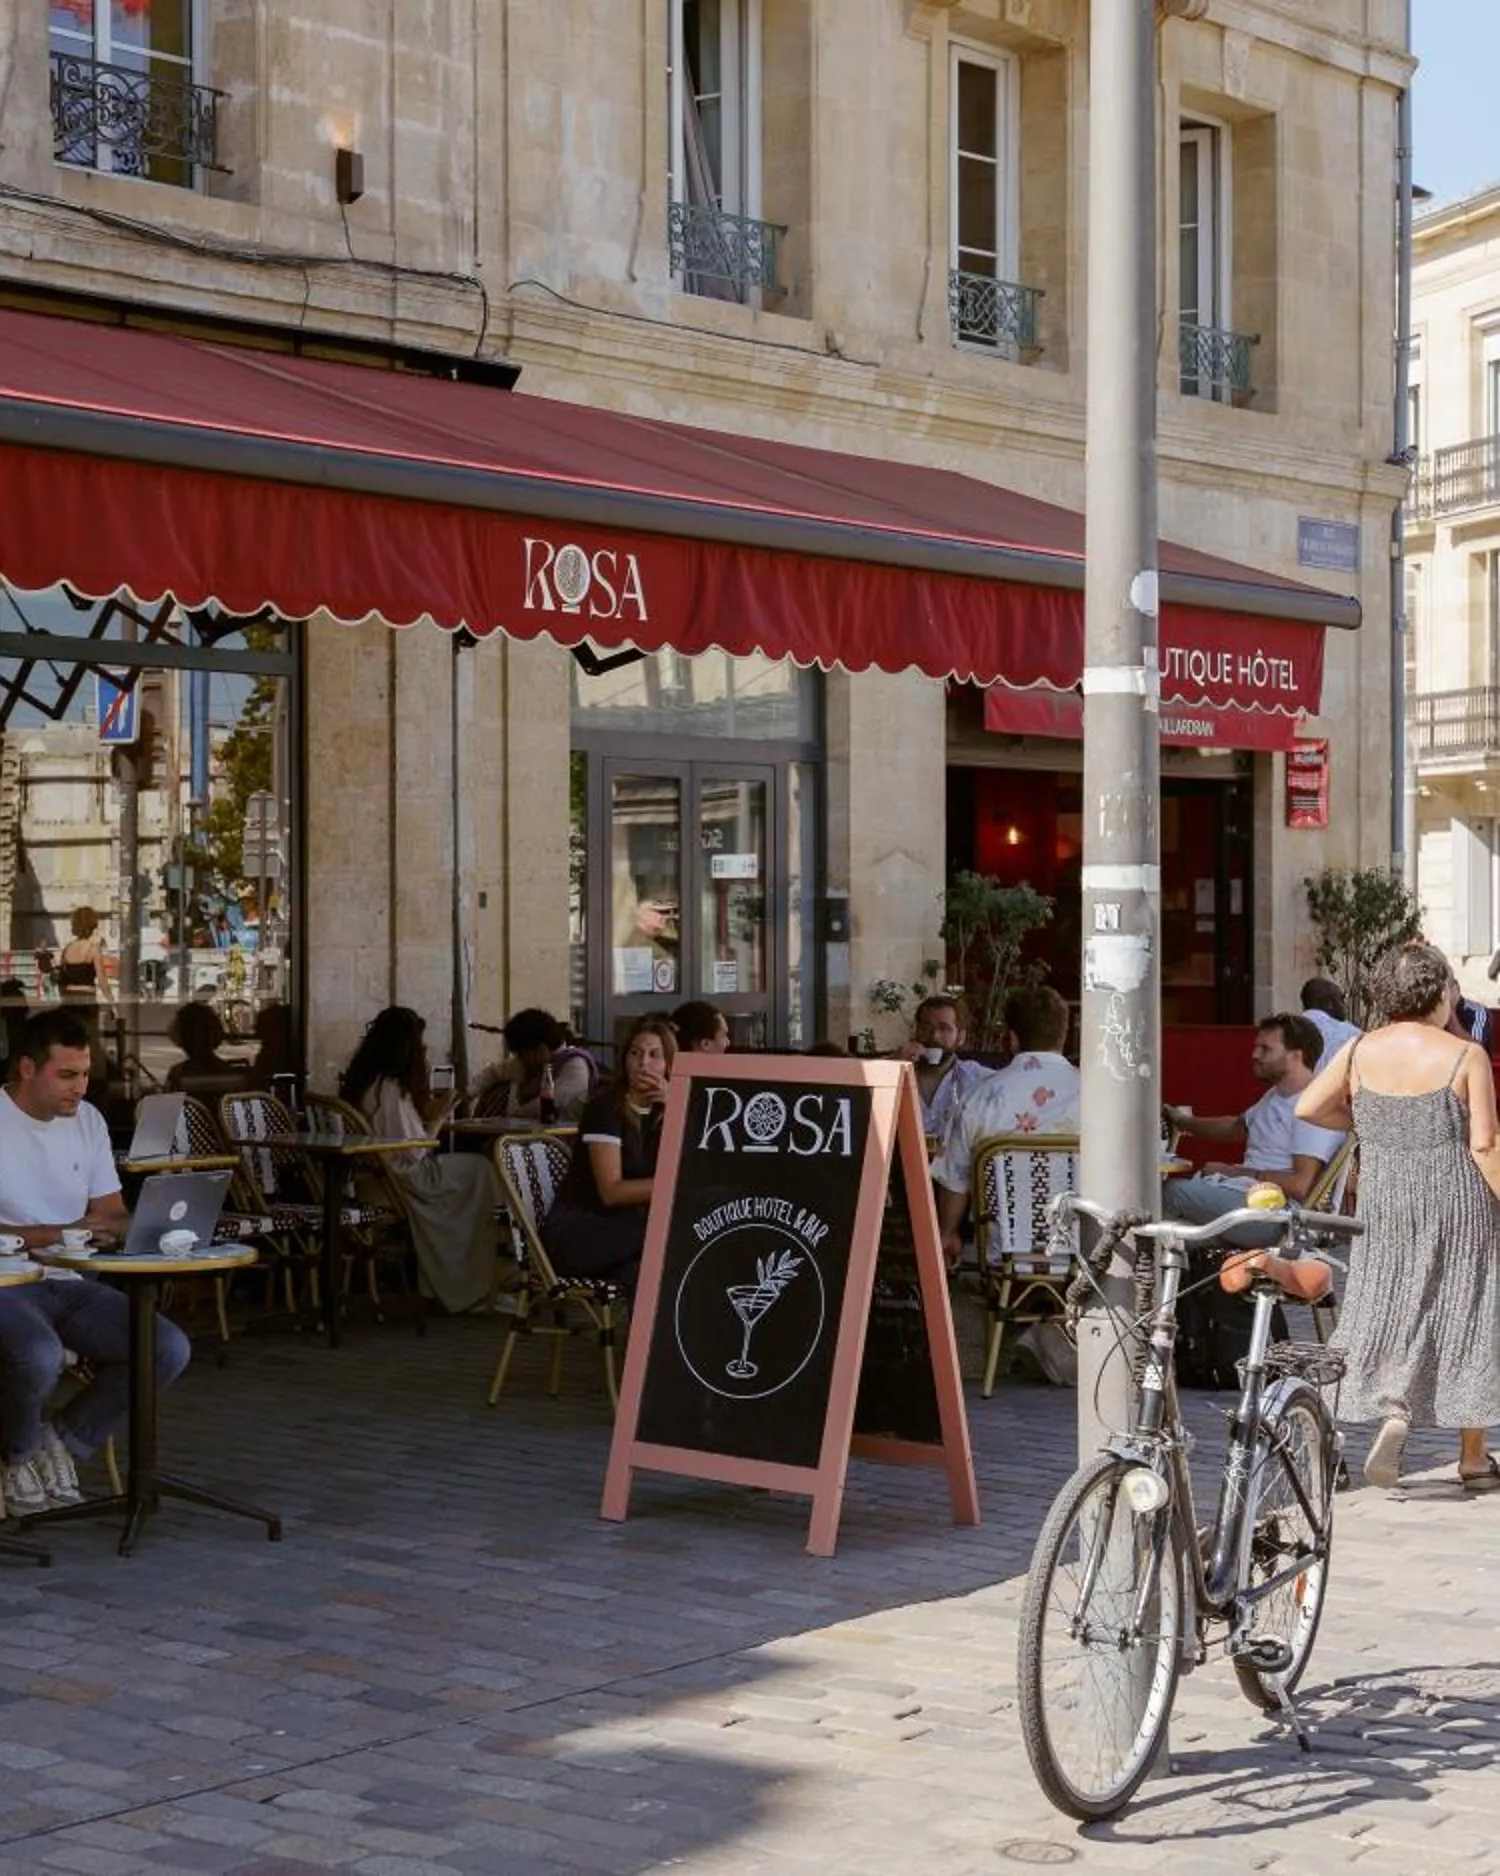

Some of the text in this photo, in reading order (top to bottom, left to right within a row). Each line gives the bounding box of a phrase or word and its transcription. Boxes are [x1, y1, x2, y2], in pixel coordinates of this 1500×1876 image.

[522, 536, 648, 621] ROSA
[1159, 647, 1299, 691] UTIQUE HÔTEL
[696, 1086, 853, 1157] ROSA
[692, 1196, 830, 1248] BOUTIQUE HOTEL & BAR
